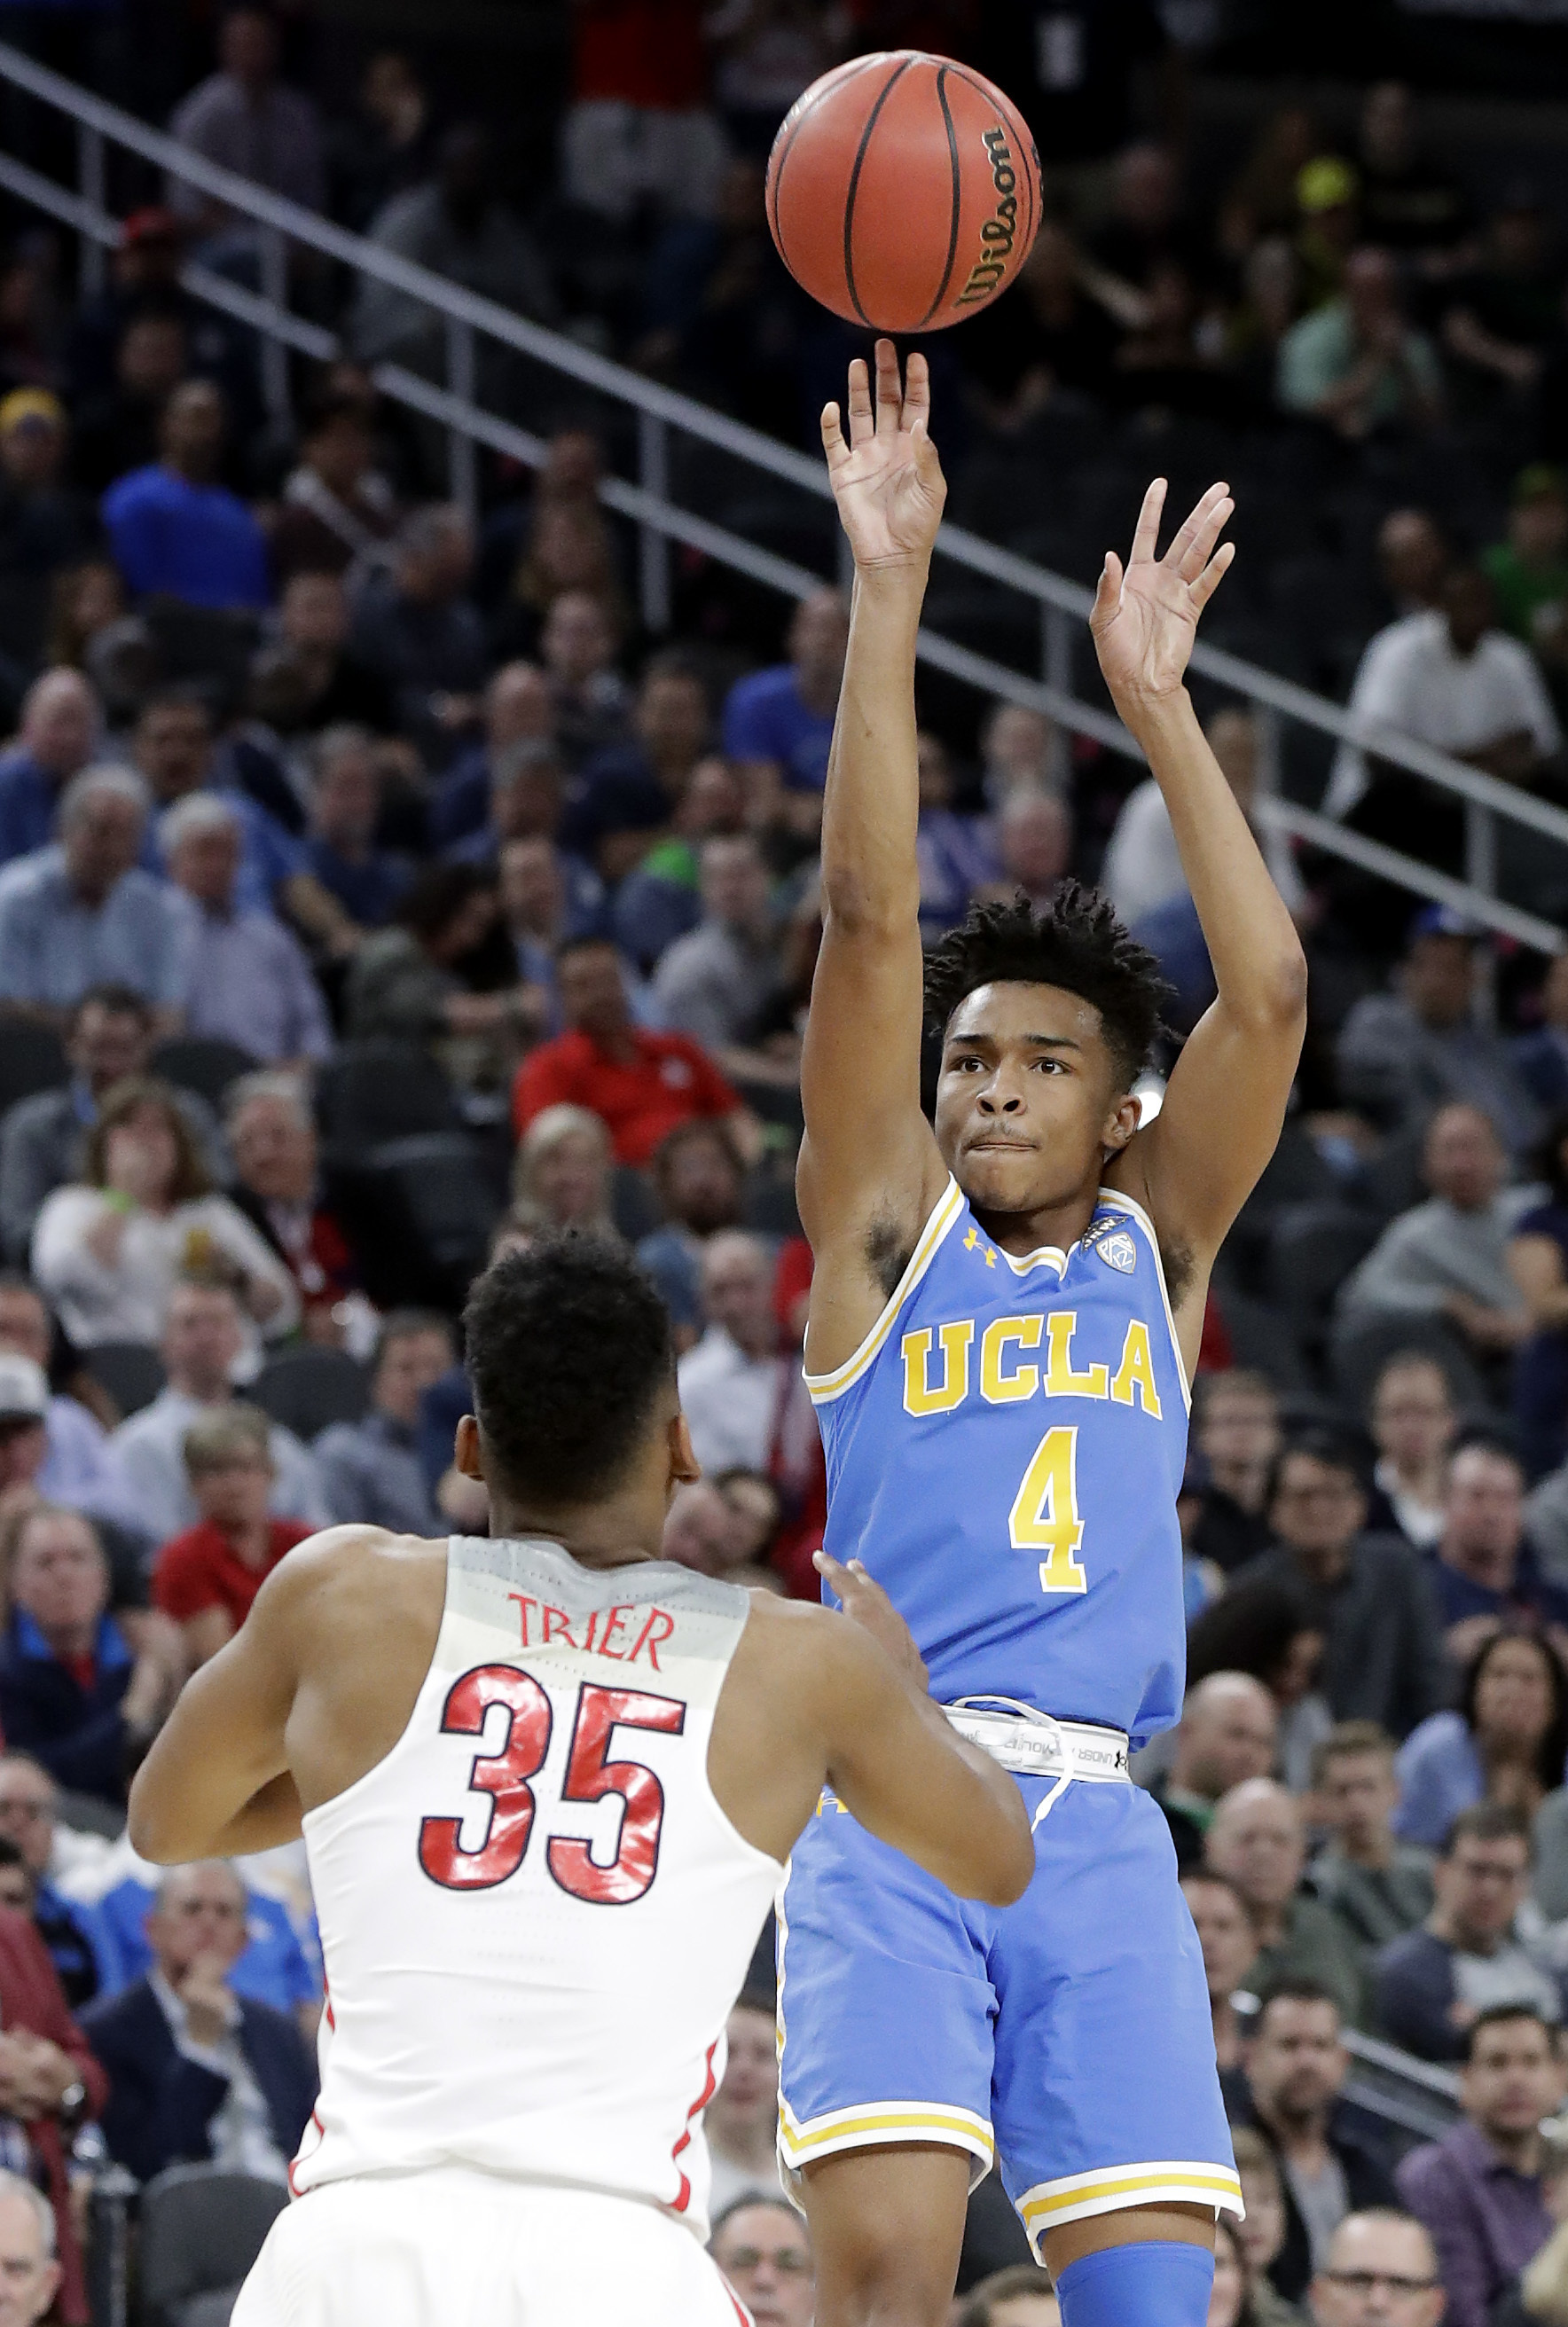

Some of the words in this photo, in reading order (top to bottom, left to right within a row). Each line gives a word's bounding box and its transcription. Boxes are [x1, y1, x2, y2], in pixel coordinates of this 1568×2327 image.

[951, 126, 1018, 309] Wilson
[1099, 1234, 1134, 1264] PAC
[1112, 1249, 1133, 1268] 12
[900, 1311, 1163, 1421] UCLA
[1008, 1425, 1087, 1594] 4
[508, 1593, 675, 1673] TRIER
[418, 1663, 687, 1906] 35
[1078, 1747, 1112, 1764] UNDER
